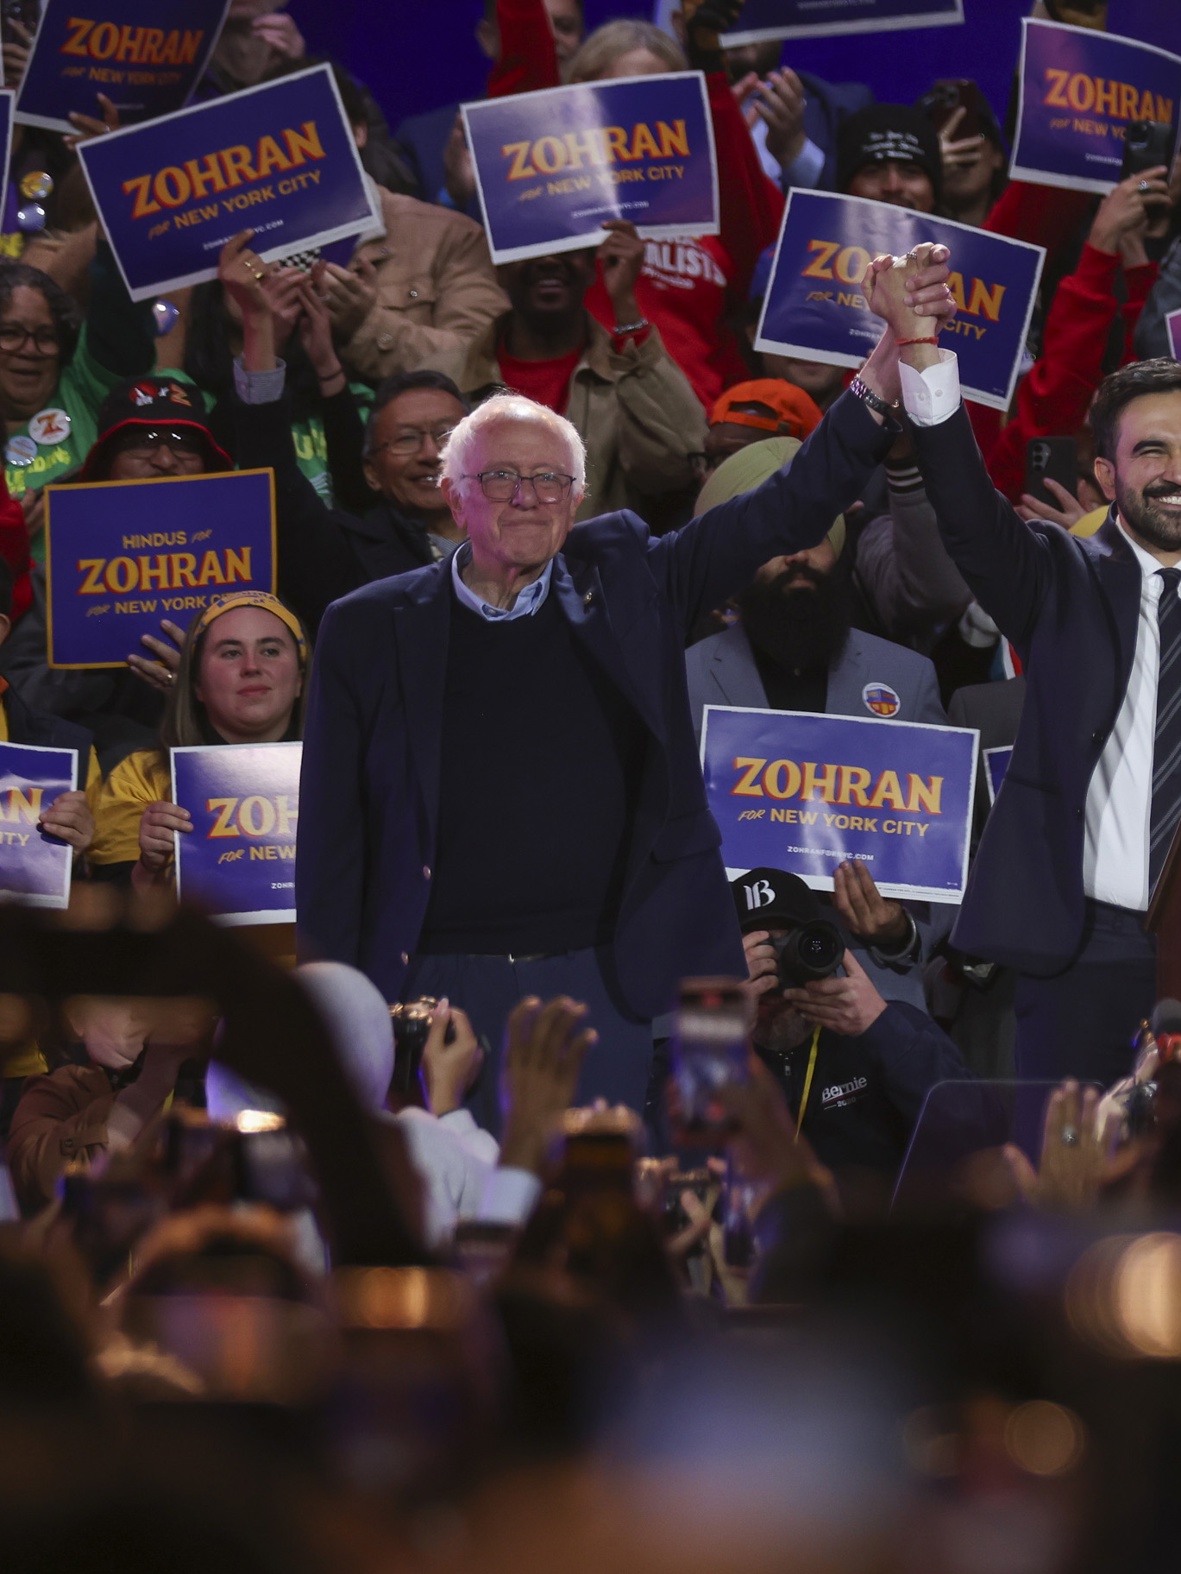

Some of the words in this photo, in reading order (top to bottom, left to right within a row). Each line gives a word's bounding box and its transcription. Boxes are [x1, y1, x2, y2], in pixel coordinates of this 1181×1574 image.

[60, 17, 204, 64] ZOHRAN
[1044, 68, 1173, 124] ZOHRAN
[502, 119, 691, 182] ZOHRAN
[1073, 118, 1108, 136] NEW
[122, 121, 326, 219] ZOHRAN
[548, 176, 591, 196] NEW
[648, 166, 685, 180] CITY
[174, 203, 219, 229] NEW
[222, 185, 276, 213] YORK
[278, 170, 322, 196] CITY
[802, 239, 1006, 321] ZOAN
[123, 531, 187, 549] HINDUS
[77, 547, 252, 595] ZOHRAN
[115, 601, 157, 614] NEW
[161, 598, 206, 610] YORK
[731, 757, 944, 815] ZOHRAN
[770, 808, 818, 825] NEW
[824, 814, 877, 832] YORK
[883, 821, 929, 837] CITY
[250, 846, 295, 861] NEW
[821, 1077, 868, 1103] Bernie
